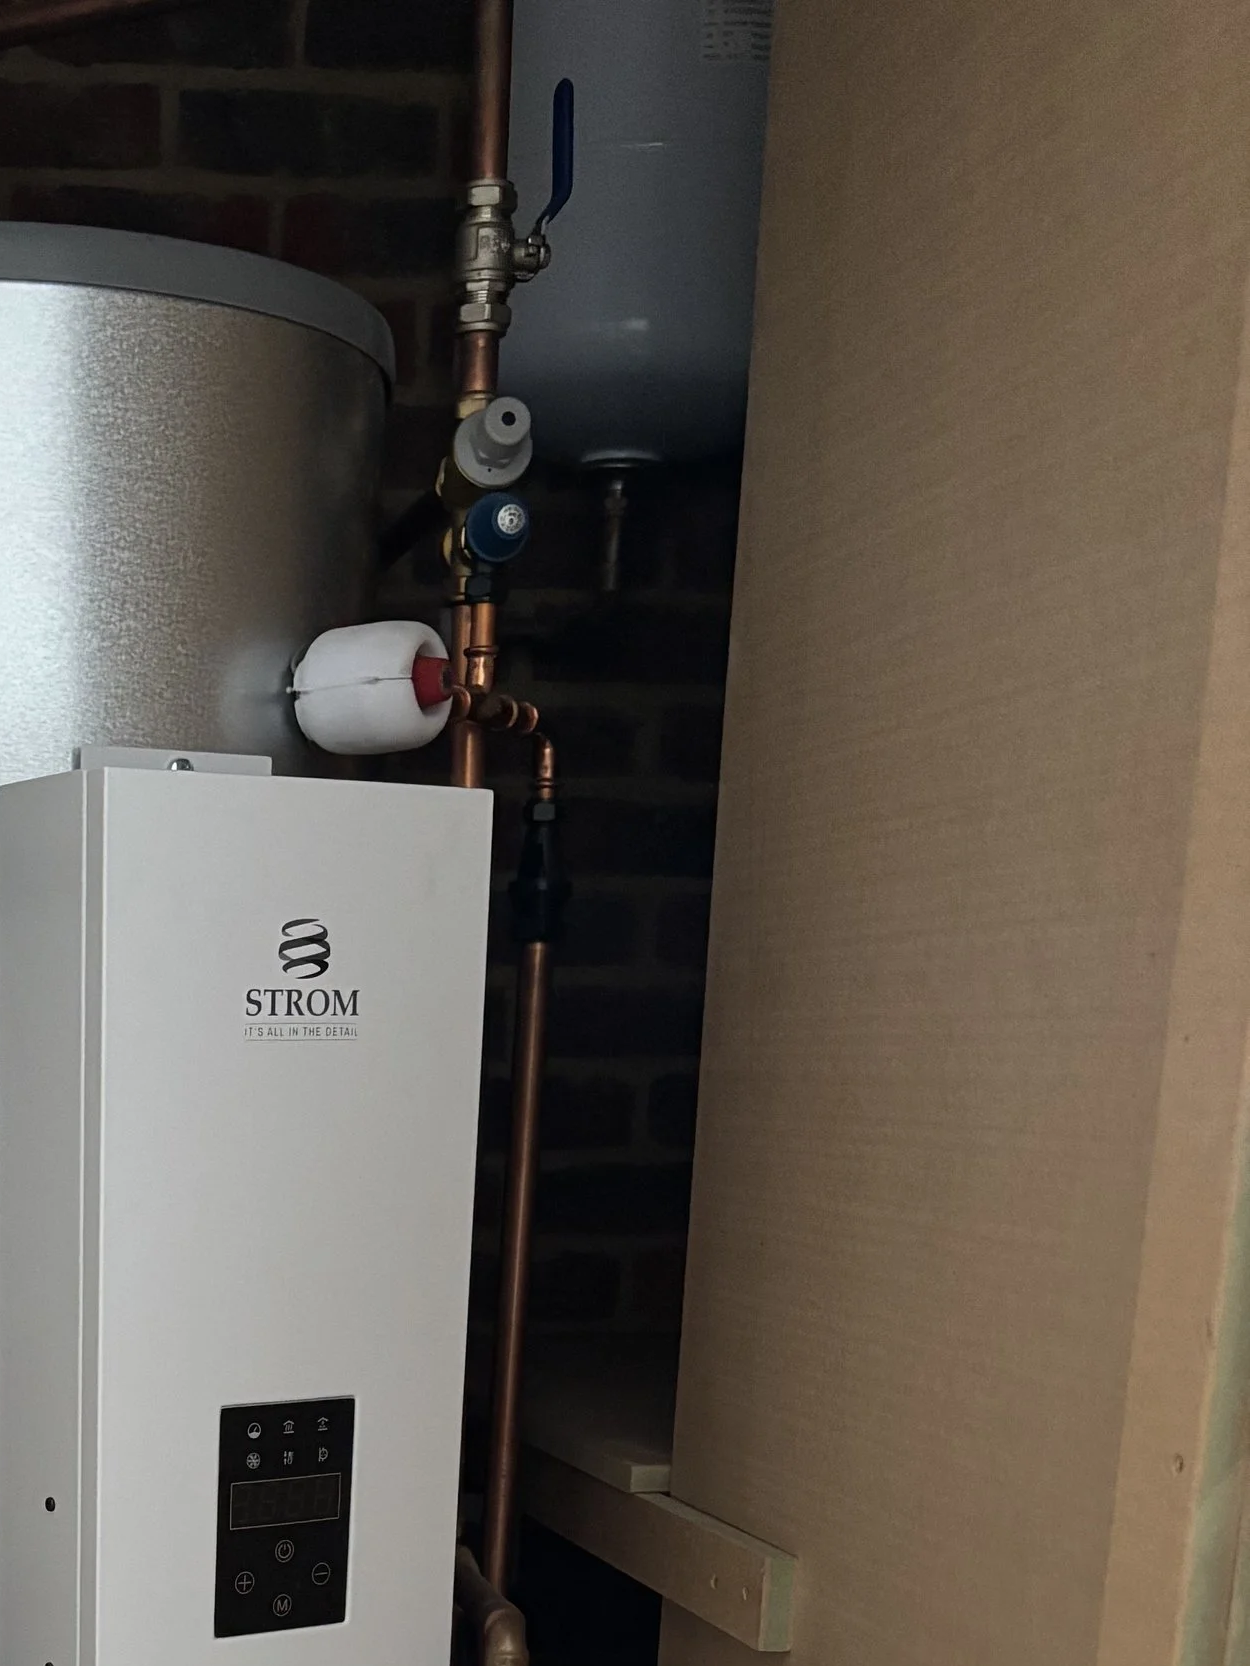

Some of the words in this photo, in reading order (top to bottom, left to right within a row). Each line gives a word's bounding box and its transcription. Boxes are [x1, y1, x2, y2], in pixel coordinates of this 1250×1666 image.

[245, 988, 360, 1017] STROM
[244, 1026, 264, 1037] IT'S
[266, 1026, 284, 1037] ALL
[288, 1026, 299, 1037] IN
[303, 1026, 321, 1037] THE
[325, 1026, 358, 1037] DETAIL
